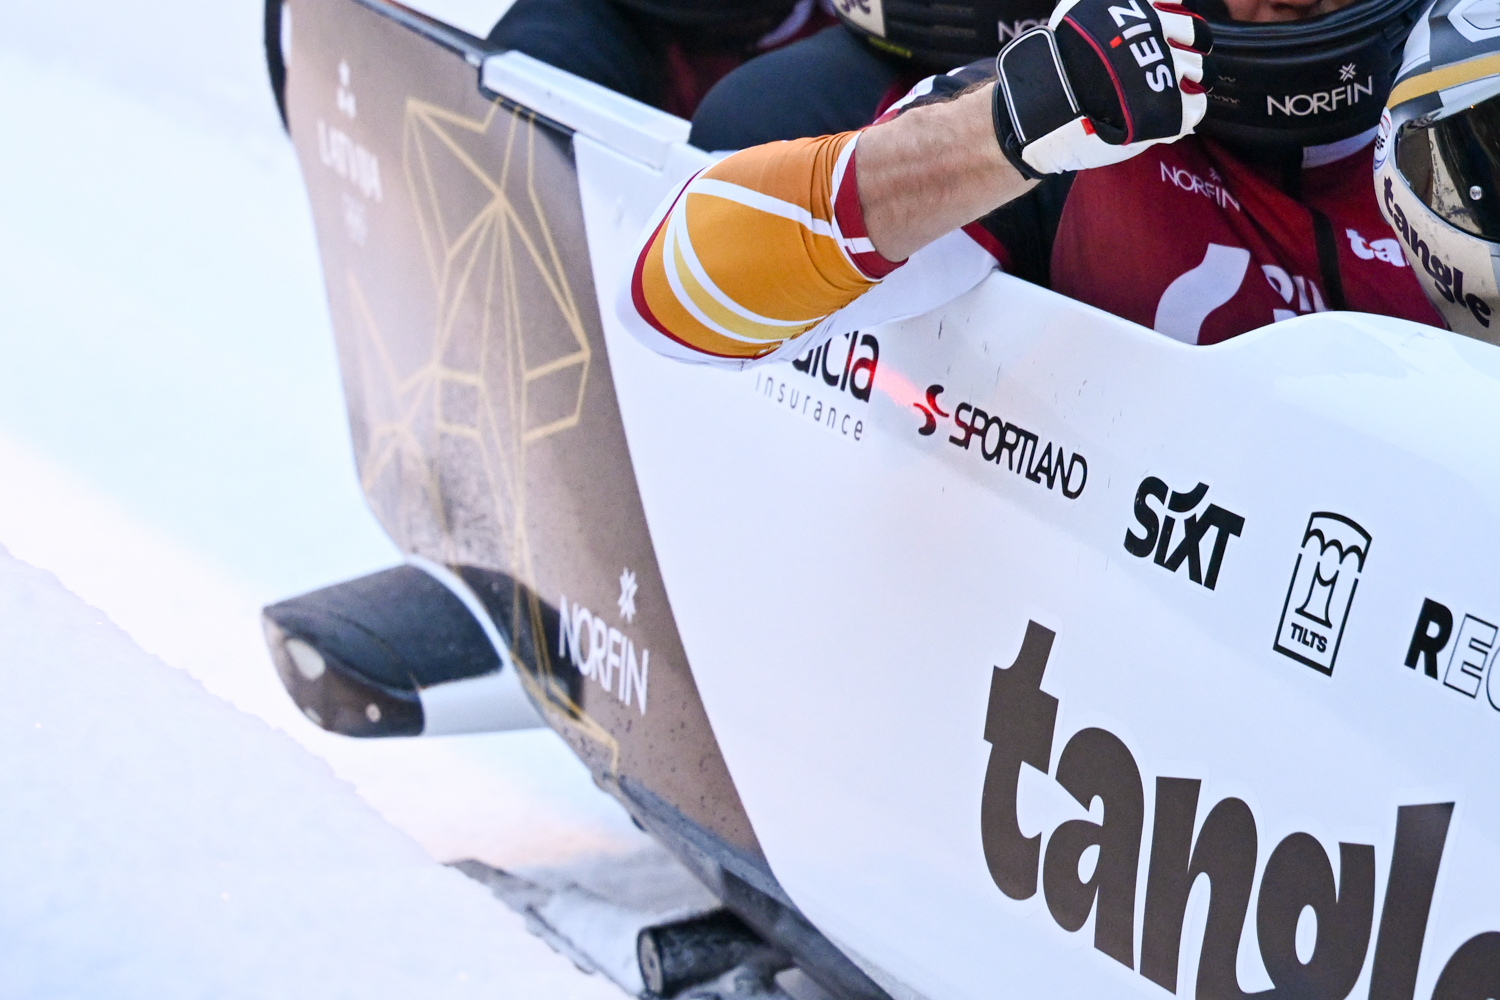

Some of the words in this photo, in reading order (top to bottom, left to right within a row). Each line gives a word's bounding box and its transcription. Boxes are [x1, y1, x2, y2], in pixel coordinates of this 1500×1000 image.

[1267, 75, 1373, 116] NORFIN
[1160, 161, 1240, 212] NORFIN
[1383, 176, 1491, 328] tangle
[755, 371, 864, 441] insurance
[949, 402, 1088, 500] SPORTLAND
[558, 594, 650, 716] NORFIN
[1291, 621, 1328, 653] TILTS
